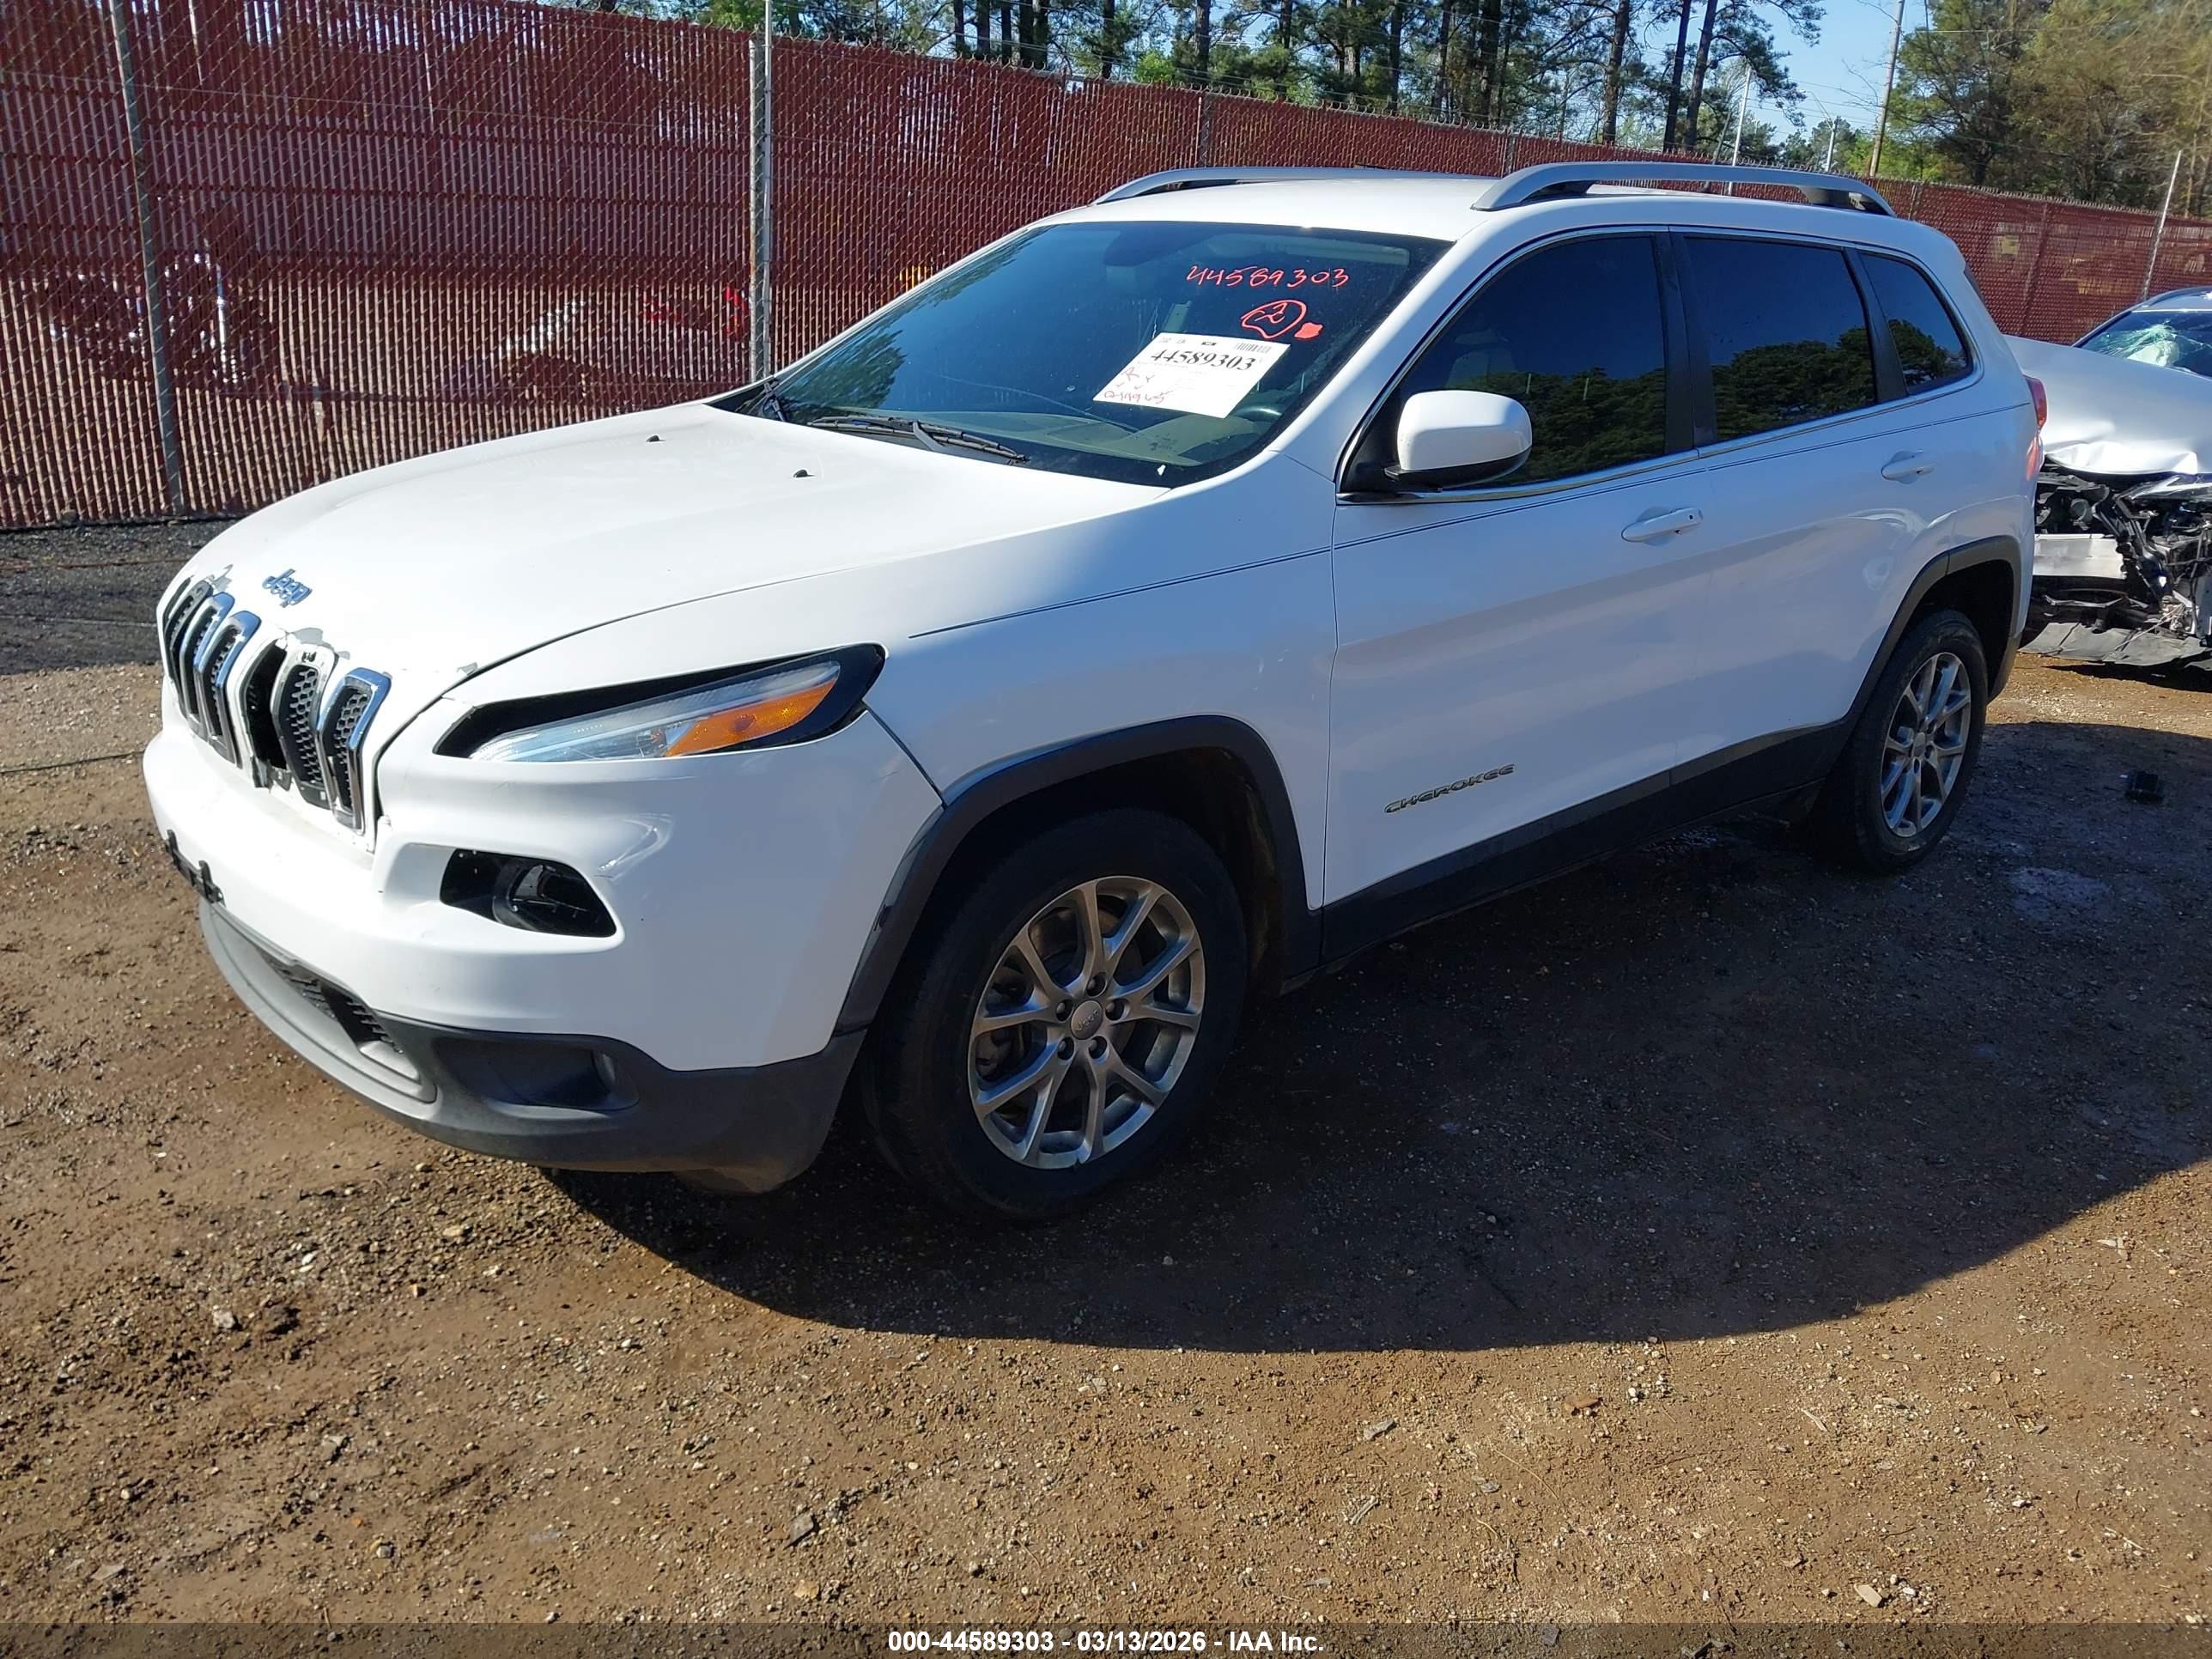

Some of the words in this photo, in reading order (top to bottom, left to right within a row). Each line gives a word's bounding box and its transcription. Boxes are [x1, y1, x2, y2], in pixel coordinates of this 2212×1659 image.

[1187, 265, 1350, 288] 44589303
[1151, 349, 1256, 371] 44589303
[262, 568, 313, 608] Jeep
[1384, 763, 1515, 813] CHEROKEE
